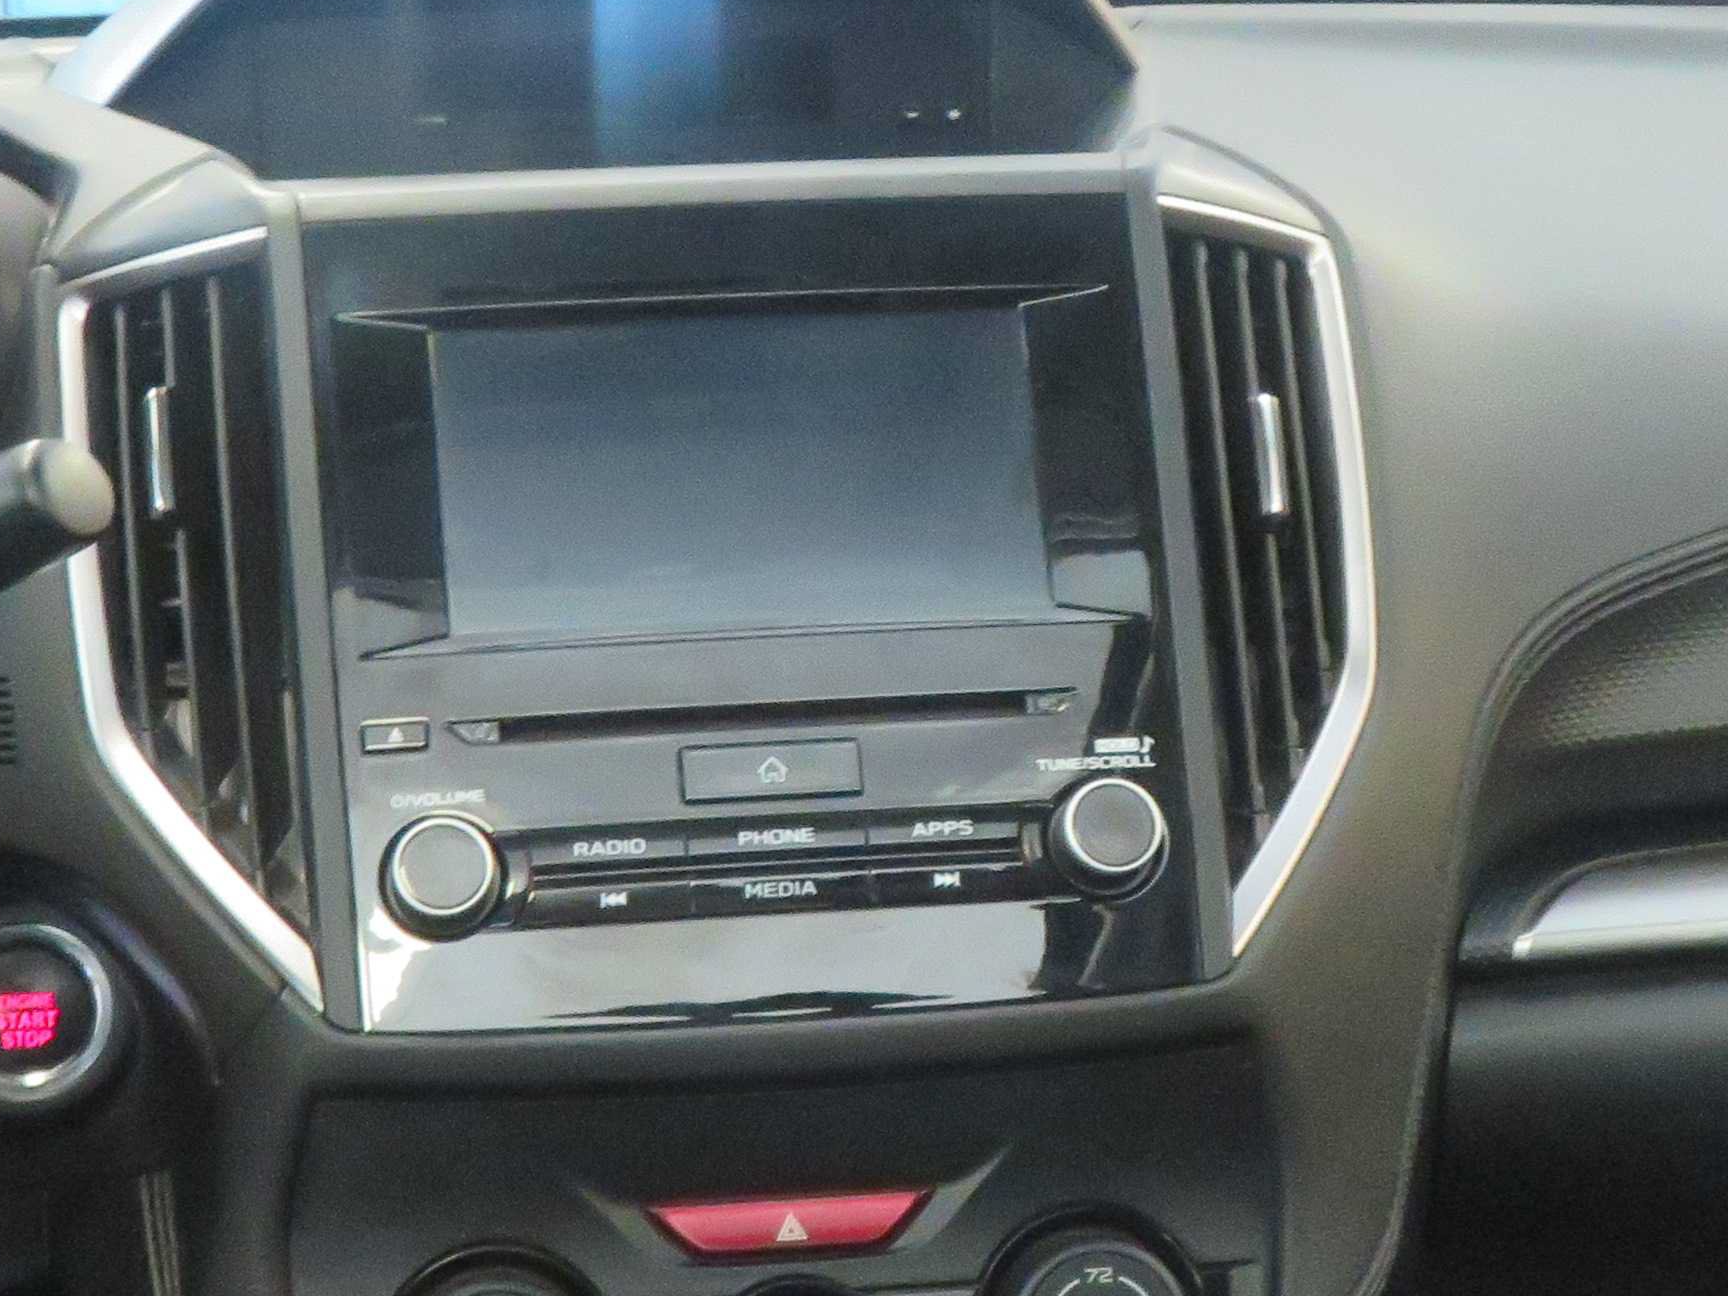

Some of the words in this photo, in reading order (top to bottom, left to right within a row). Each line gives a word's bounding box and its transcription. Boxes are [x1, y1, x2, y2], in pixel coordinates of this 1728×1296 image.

[737, 827, 816, 846] PHONE
[911, 819, 974, 838] APPS
[573, 838, 647, 856] RADIO
[744, 880, 818, 898] MEDIA
[0, 1029, 57, 1050] STOP
[1083, 1266, 1114, 1284] 72
